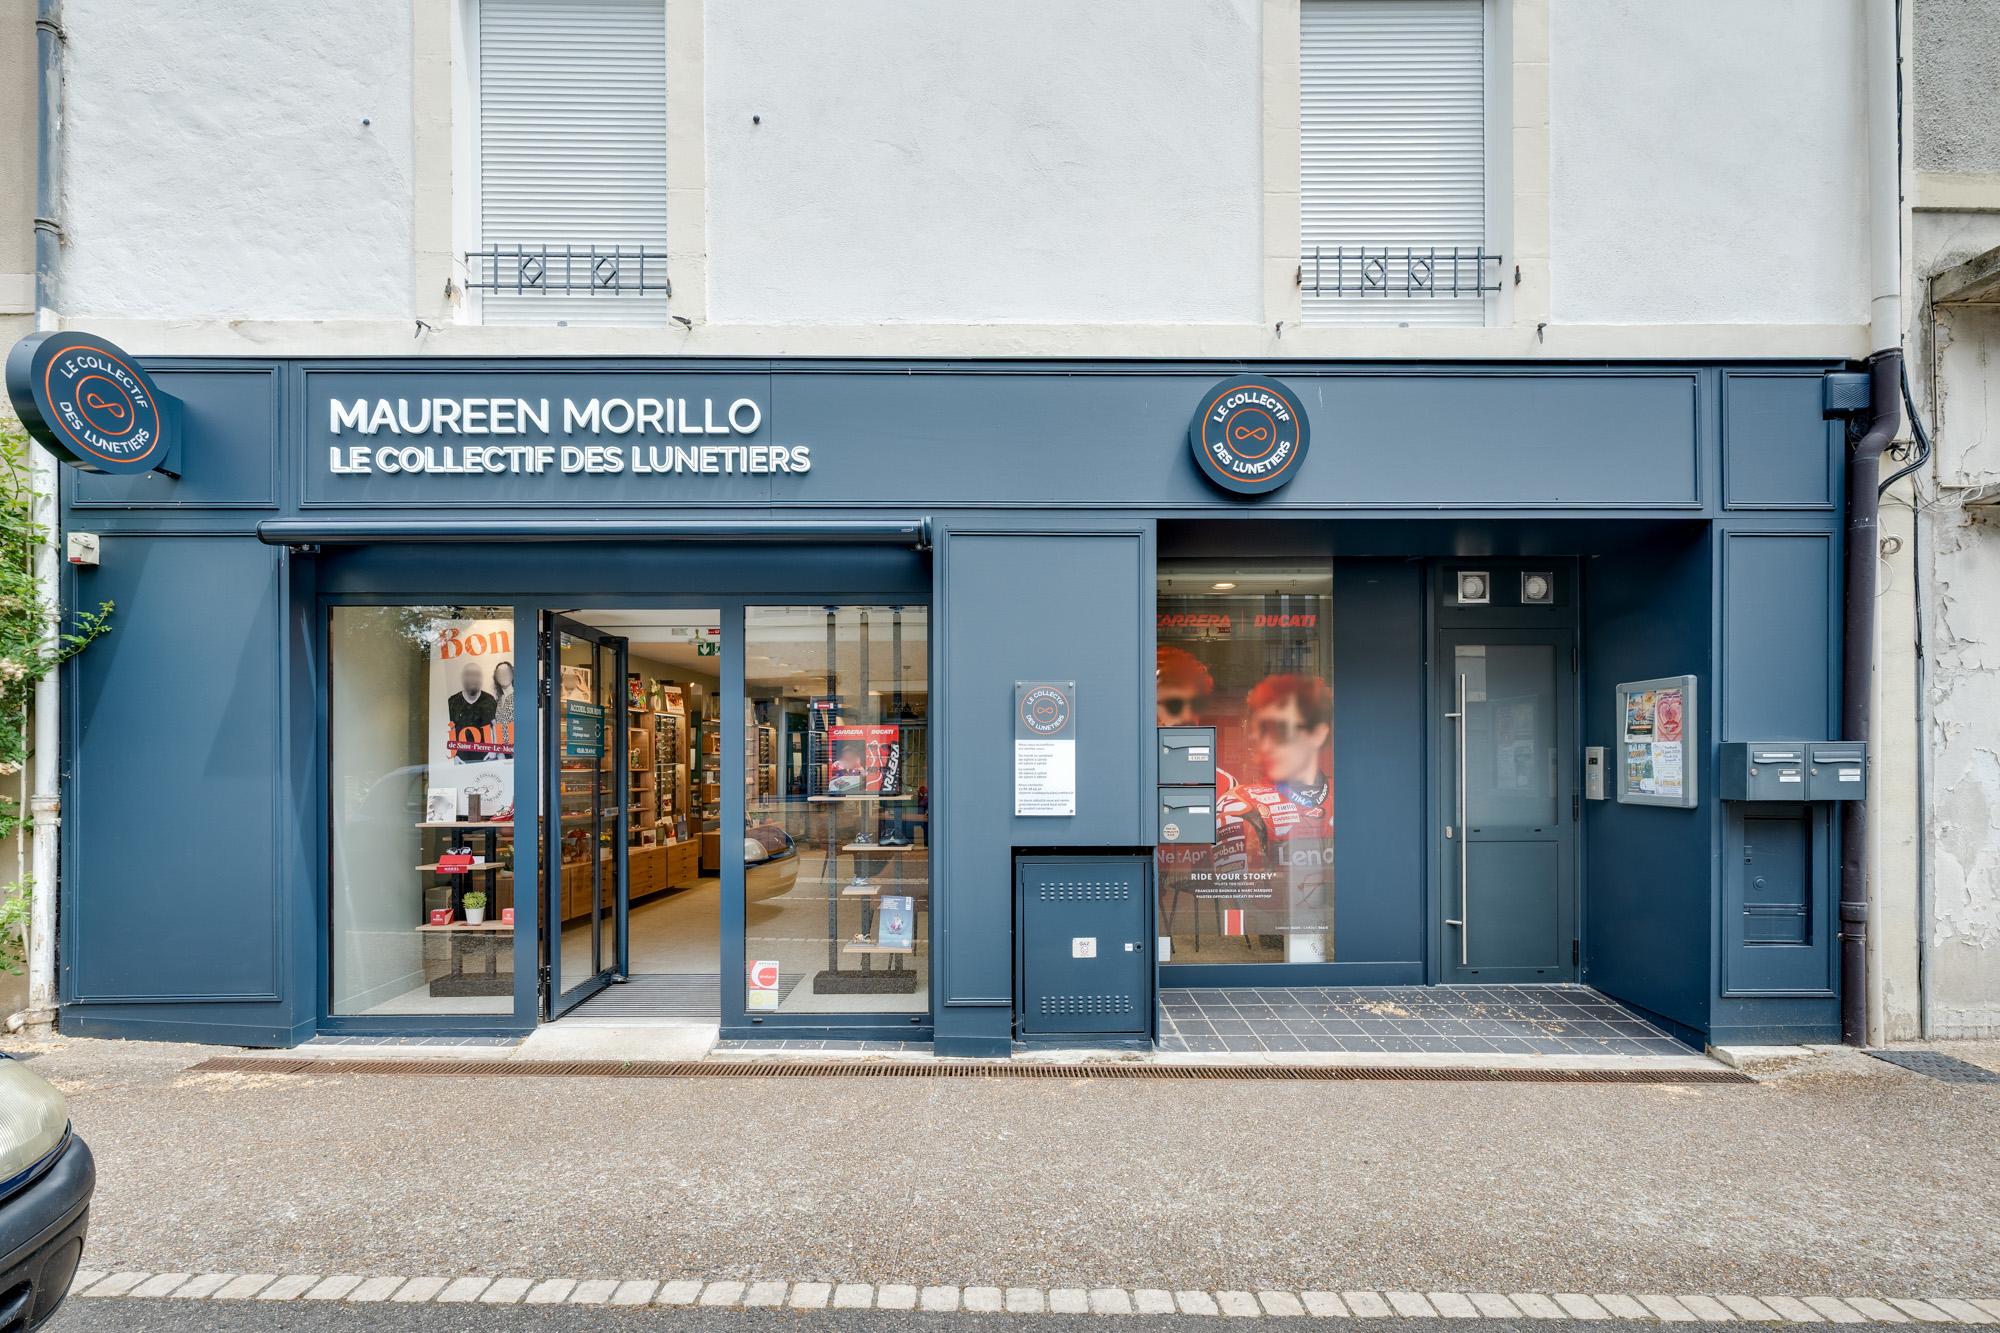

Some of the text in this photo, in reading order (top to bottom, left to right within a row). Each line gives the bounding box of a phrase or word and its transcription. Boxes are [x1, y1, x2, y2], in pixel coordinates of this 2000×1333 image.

[60, 356, 148, 409] LE COLLECTIF
[330, 398, 761, 434] MAUREEN MORILLO
[1213, 392, 1289, 423] LE COLLECTIF
[60, 401, 150, 454] DES LUNETIERS
[330, 446, 810, 475] LE COLLECTIF DES LUNETIERS
[1213, 441, 1290, 474] DES LUNETIERS
[1254, 614, 1316, 627] DUCATI
[439, 628, 512, 659] Bon
